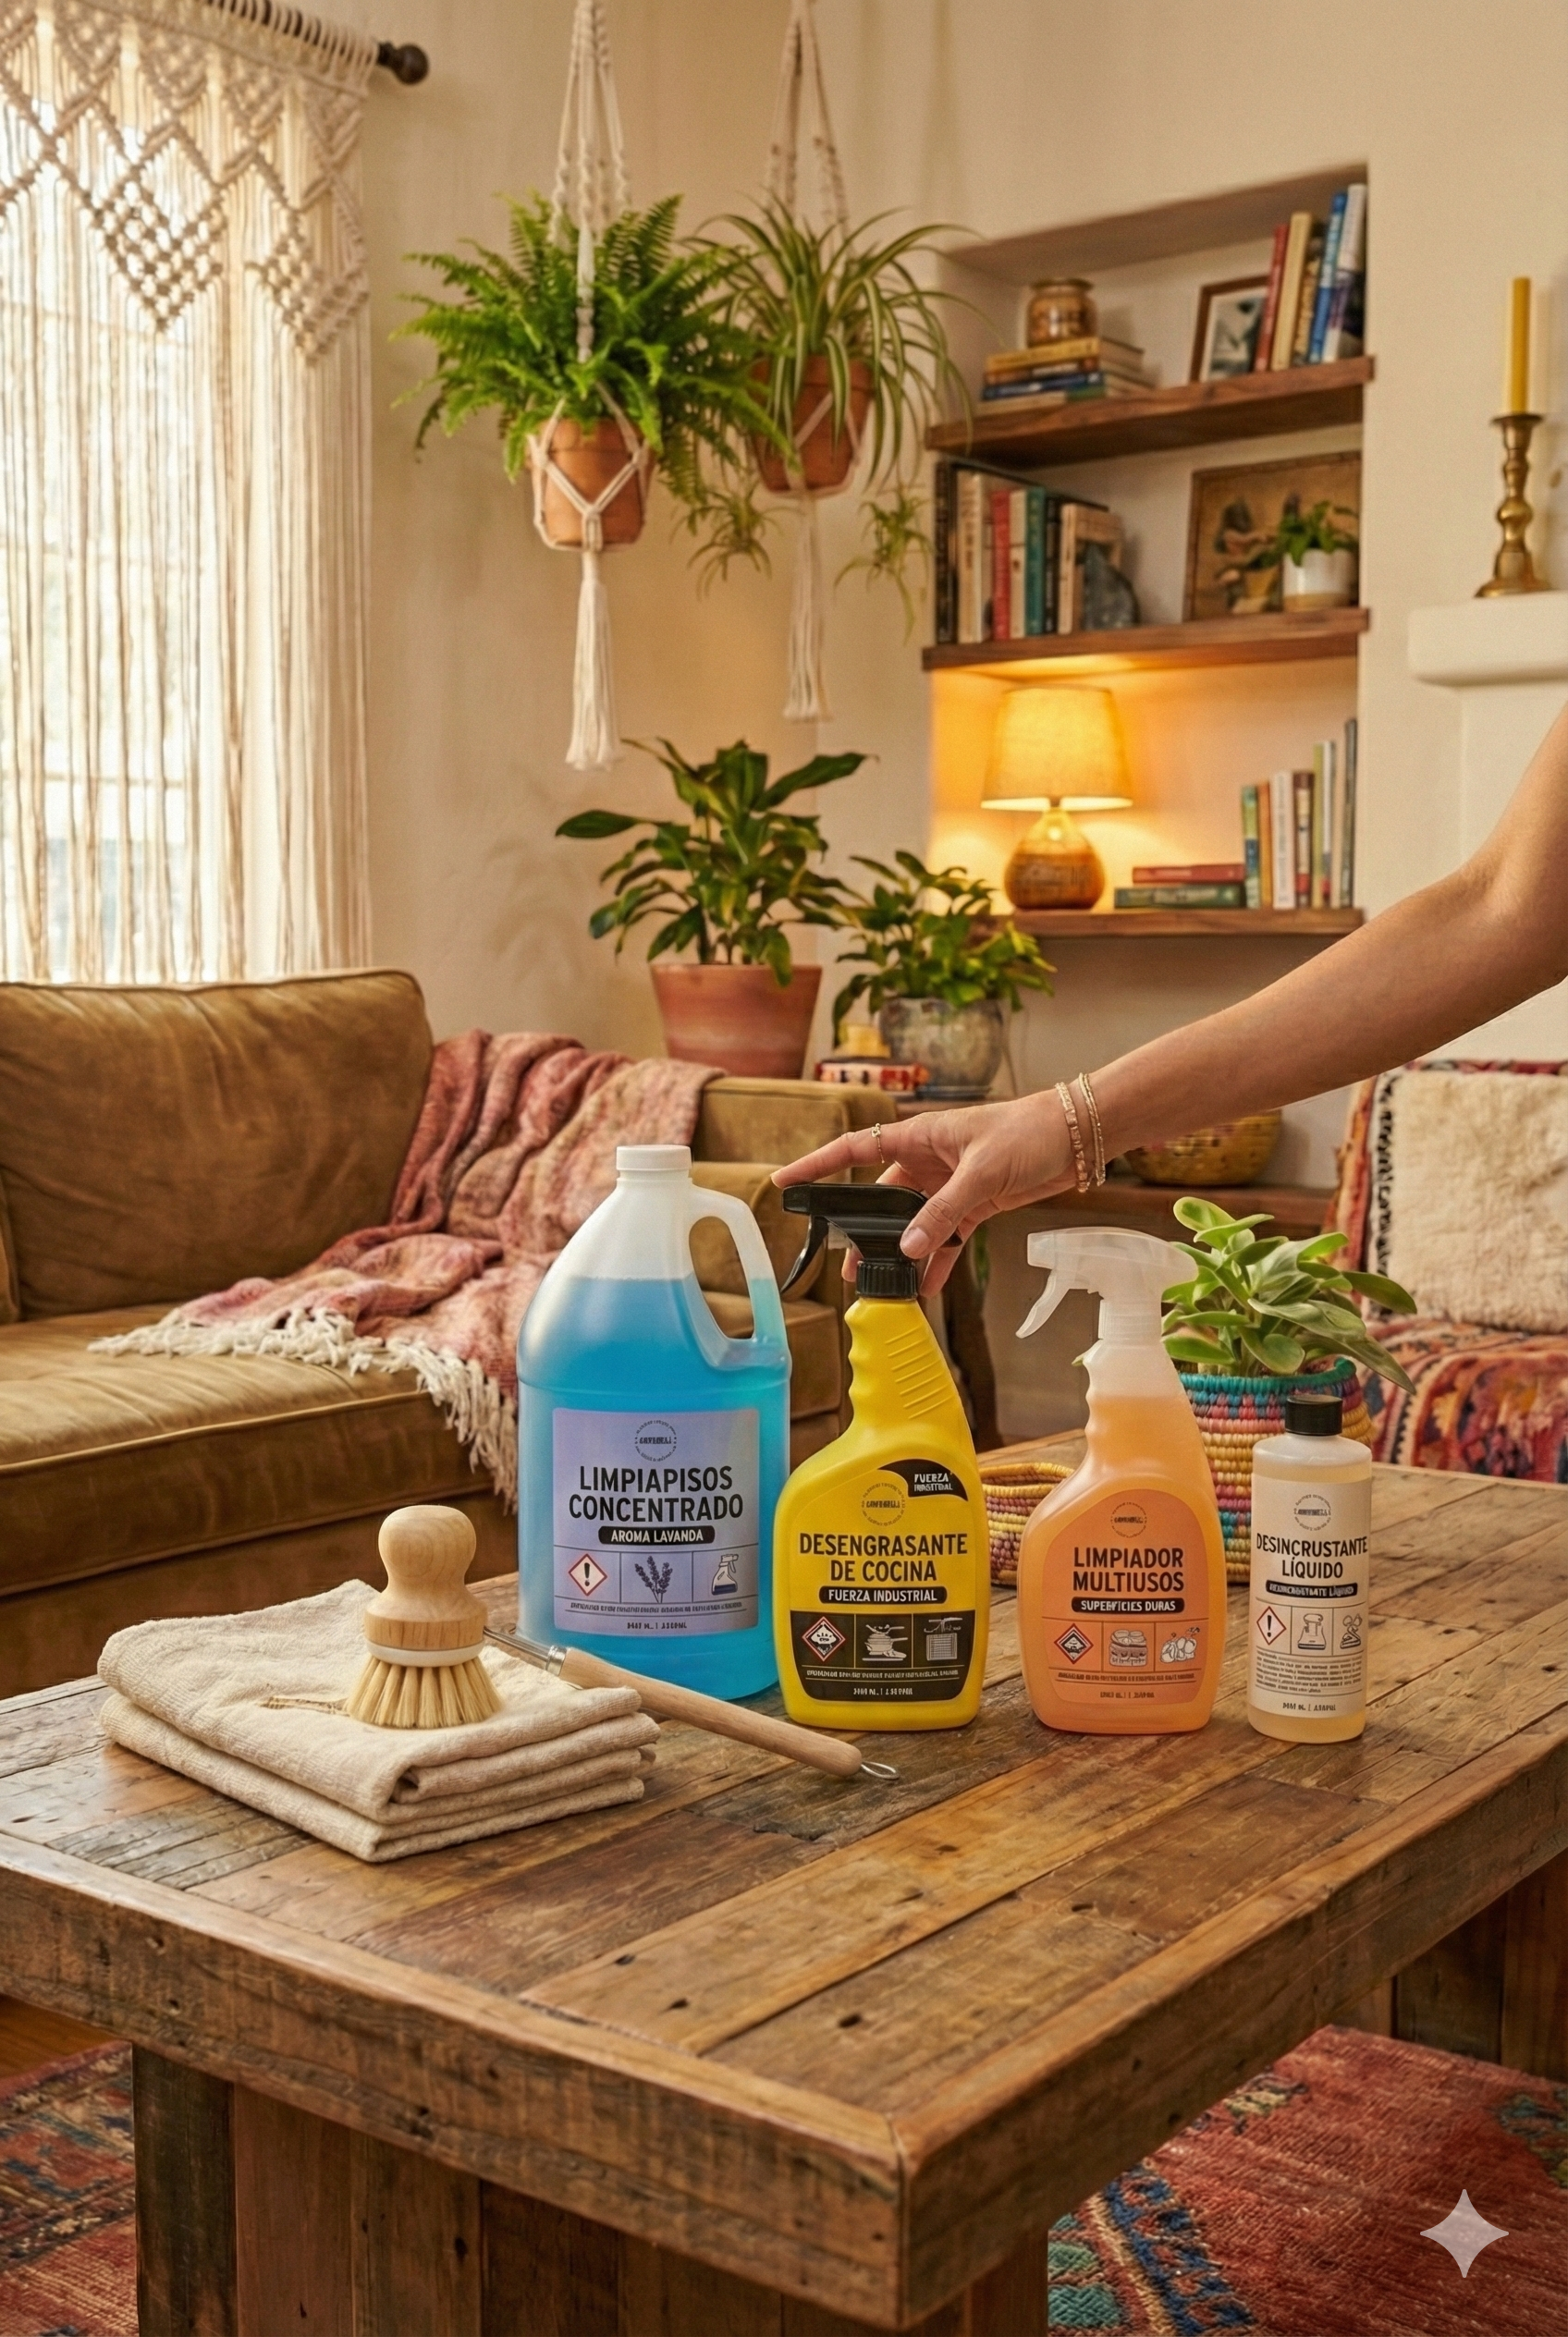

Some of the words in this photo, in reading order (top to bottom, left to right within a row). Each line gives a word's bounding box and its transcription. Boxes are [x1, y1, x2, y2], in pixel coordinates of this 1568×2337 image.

[580, 1465, 733, 1493] LIMPIAPISOS
[569, 1494, 743, 1523] CONCENTRADO
[610, 1529, 650, 1543] AROMA
[654, 1528, 704, 1543] LAVANDA
[800, 1533, 968, 1556] DESENGRASANTE
[1256, 1533, 1368, 1558] DESINCRUSTANTE
[1073, 1547, 1184, 1568] LIMPIADOR
[1281, 1557, 1343, 1579] LÍQUIDO
[830, 1560, 855, 1582] DE
[862, 1560, 937, 1582] COCINA
[1072, 1571, 1184, 1592] MULTIUSOS
[828, 1589, 871, 1602] FUERZA
[874, 1589, 937, 1602] INDUSTRIAL
[1145, 1600, 1176, 1611] DURAS
